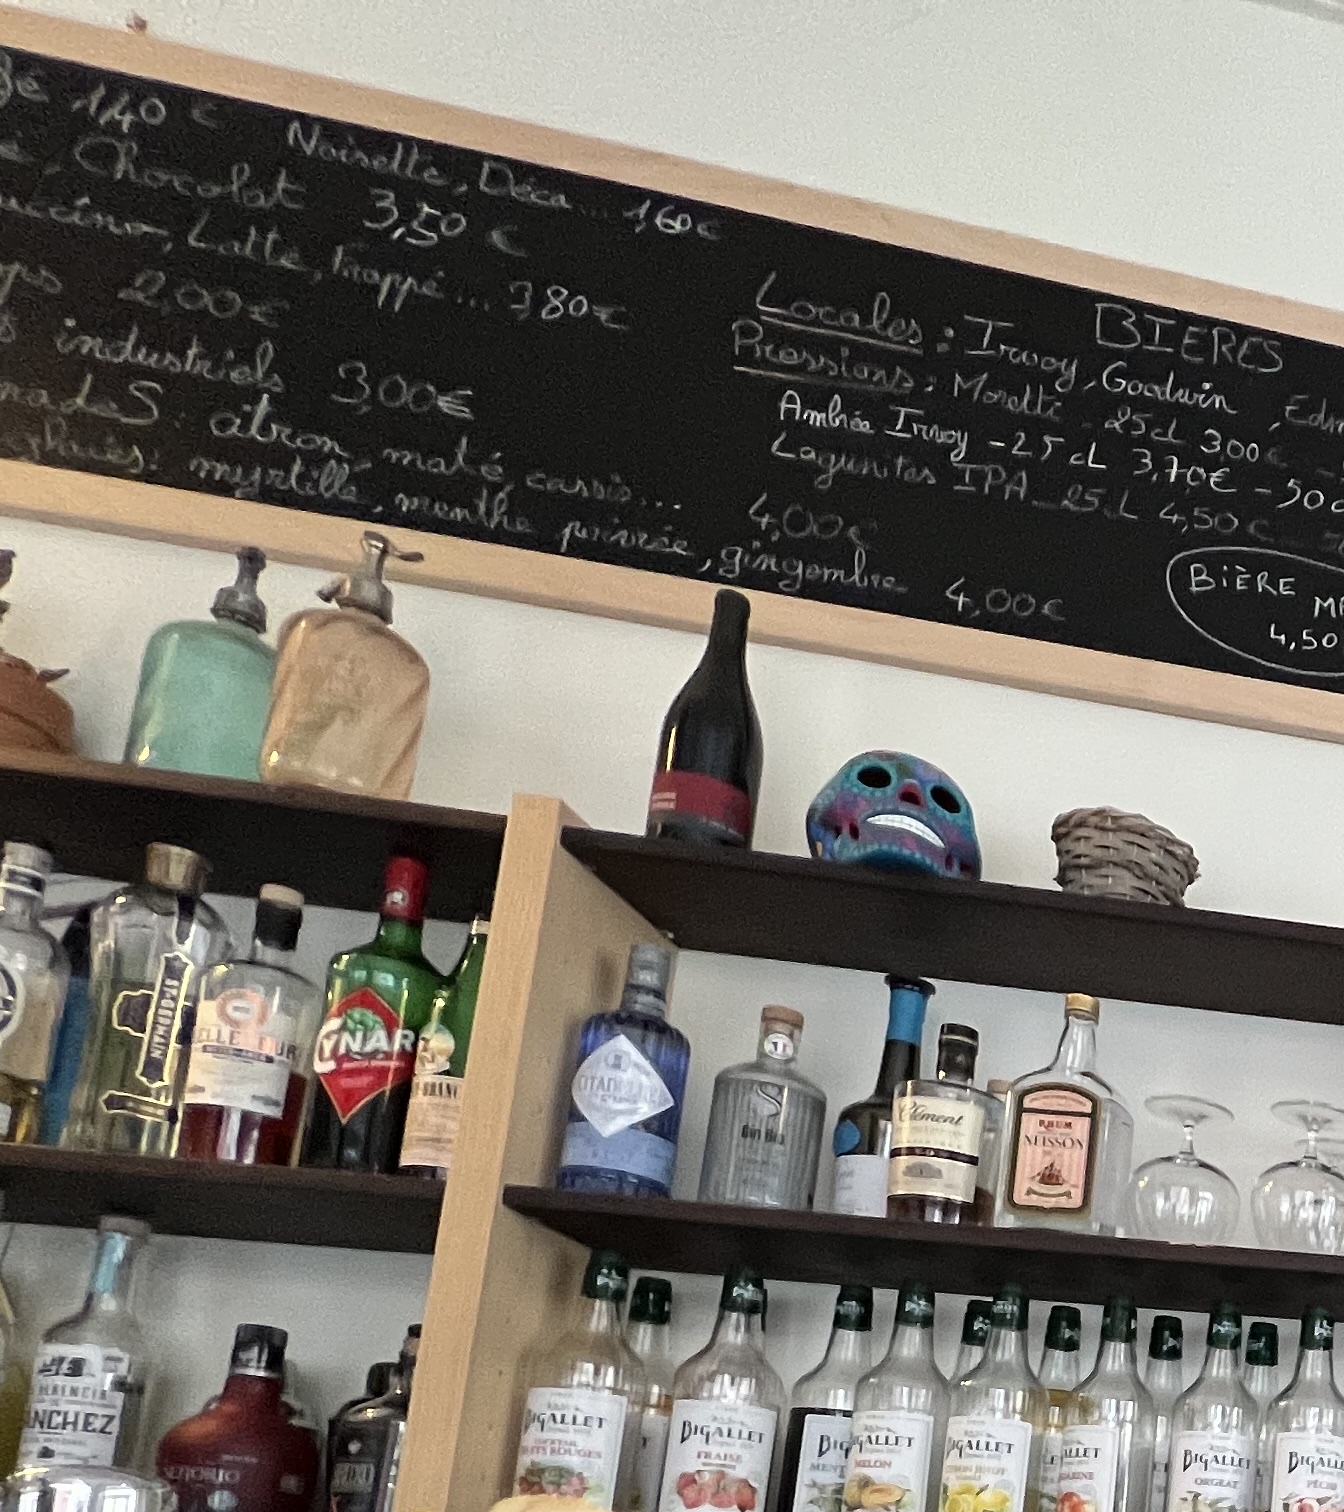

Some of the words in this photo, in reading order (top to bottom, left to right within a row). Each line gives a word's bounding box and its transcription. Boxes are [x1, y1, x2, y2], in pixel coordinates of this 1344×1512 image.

[1095, 302, 1284, 373] BIERES
[312, 1016, 417, 1075] CYNAR
[30, 1408, 117, 1436] NCHEZ
[680, 1419, 766, 1445] BIGALLET
[696, 1450, 743, 1463] FRAISE
[854, 1459, 893, 1471] MELON
[1194, 1476, 1240, 1490] ORGEAT
